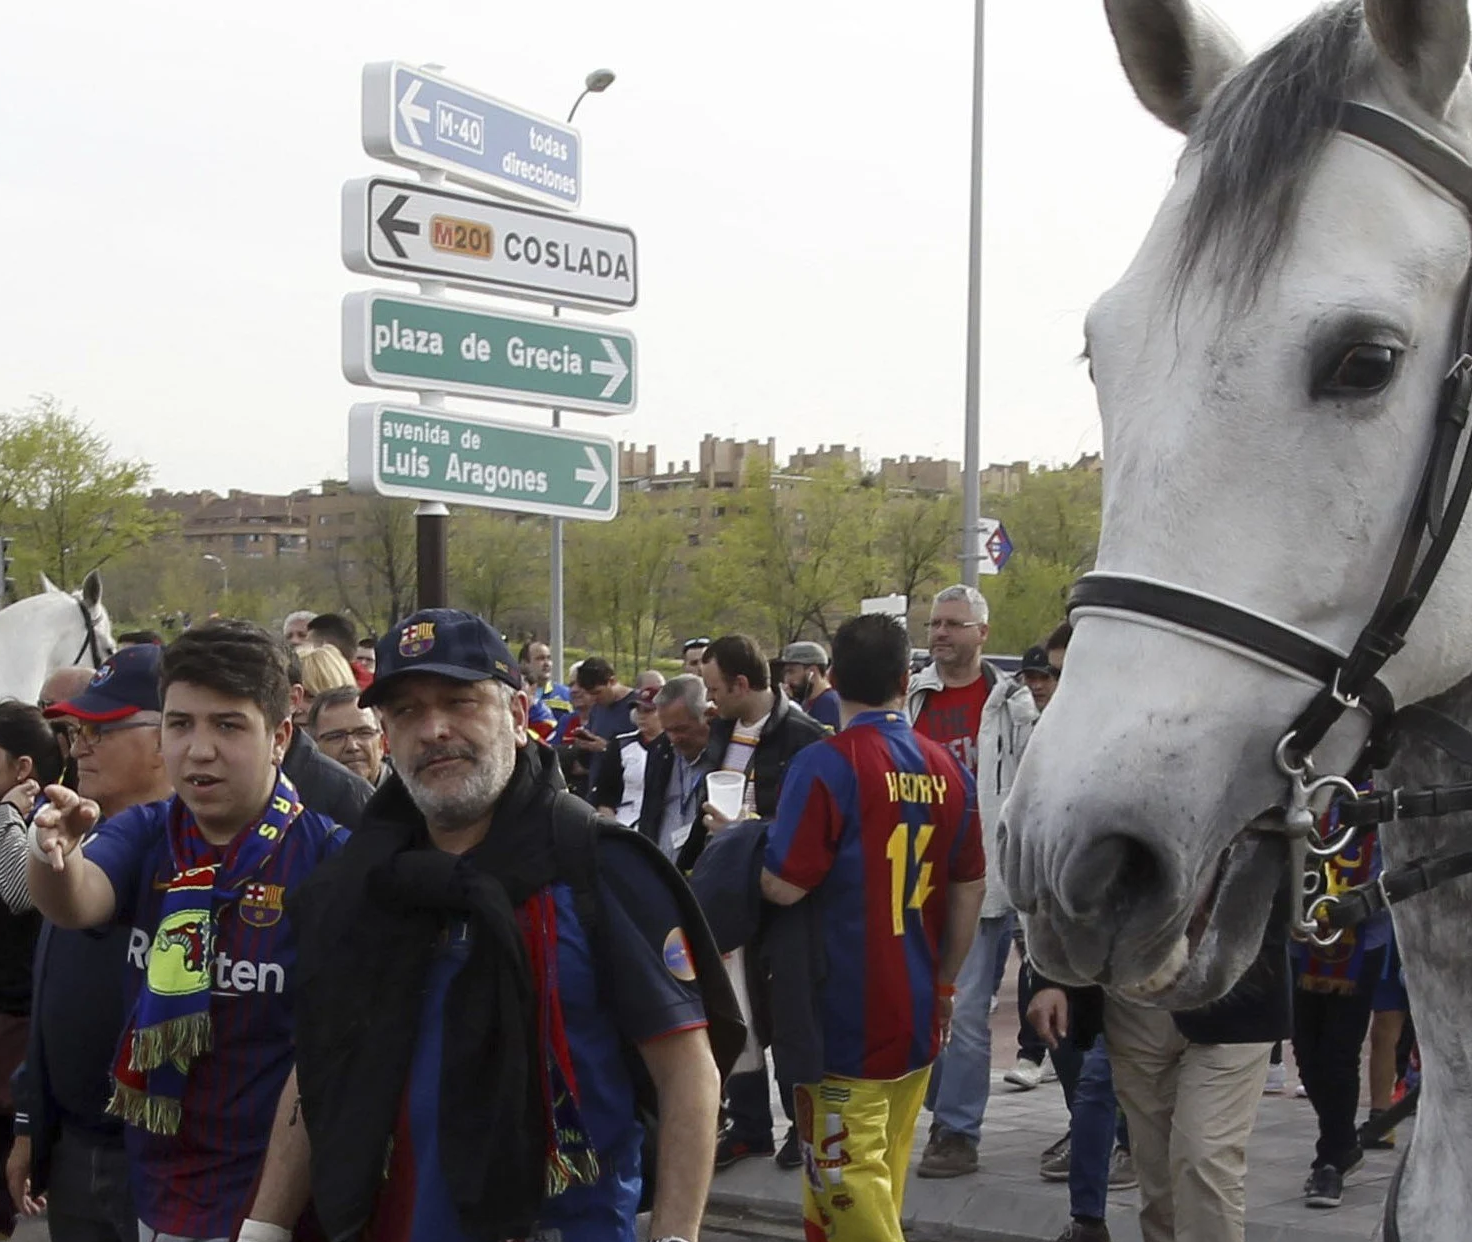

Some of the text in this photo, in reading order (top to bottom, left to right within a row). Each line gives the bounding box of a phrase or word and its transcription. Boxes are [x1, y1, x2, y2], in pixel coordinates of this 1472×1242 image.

[439, 109, 481, 146] M-40
[529, 126, 568, 161] todas
[502, 151, 576, 196] direcciones
[434, 222, 630, 282] M201 COSLADA
[375, 319, 583, 376] plaza de Grecia
[382, 420, 480, 450] avenida de
[381, 443, 548, 493] Luis Aragones
[885, 771, 947, 804] HENRY
[885, 822, 936, 936] 14
[127, 926, 285, 994] Rten
